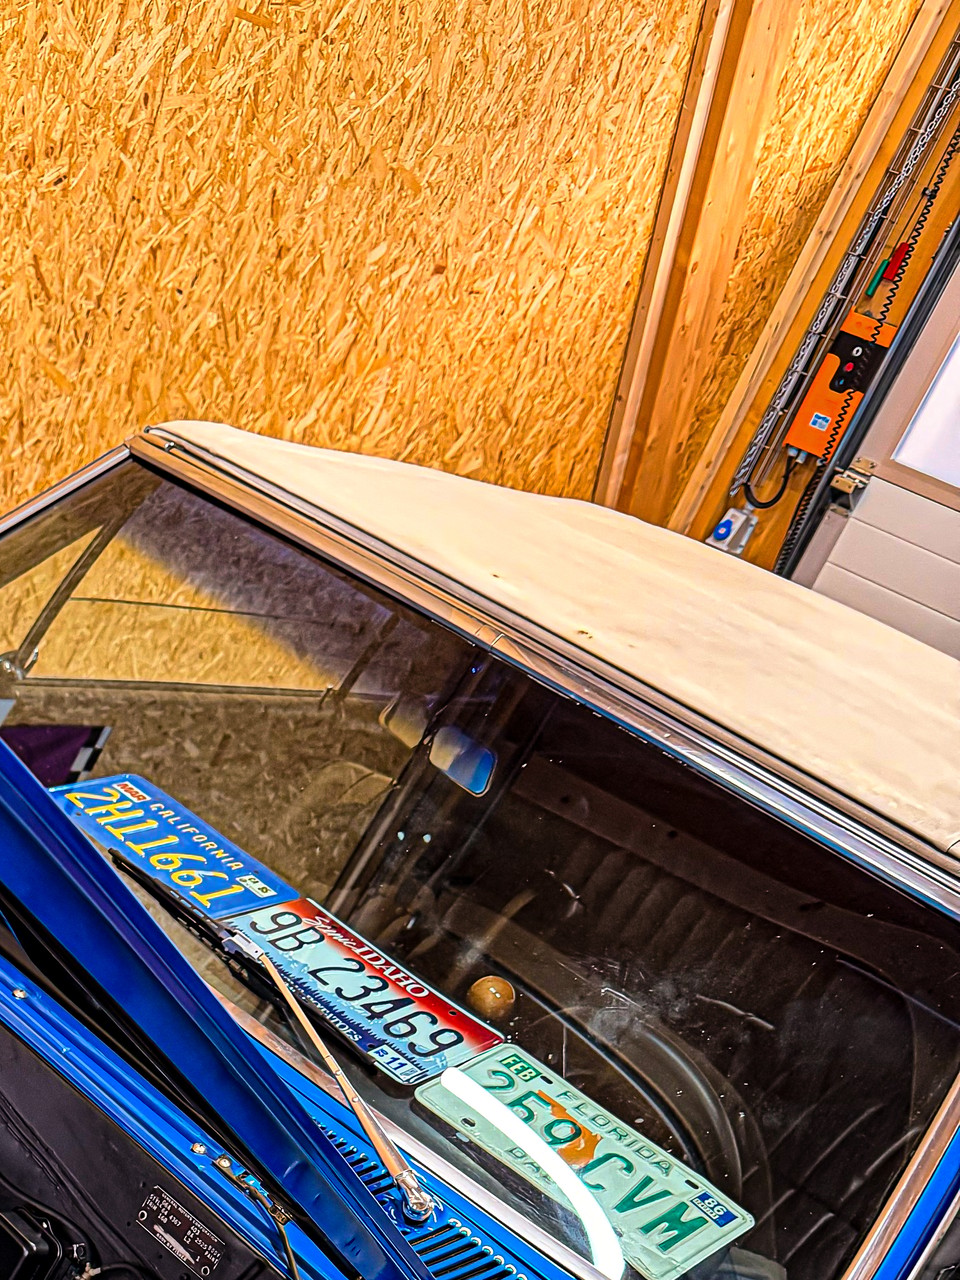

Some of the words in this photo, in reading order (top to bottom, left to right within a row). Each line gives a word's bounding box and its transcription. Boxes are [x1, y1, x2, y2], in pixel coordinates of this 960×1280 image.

[117, 782, 147, 802] MAR
[64, 787, 246, 908] 2H11661
[148, 803, 245, 871] CALIFORNIA
[249, 911, 325, 951] 9B
[307, 957, 464, 1058] 23469
[302, 915, 358, 949] Scenic
[354, 947, 430, 998] IDAHO
[502, 1054, 540, 1083] FEB
[556, 1091, 674, 1178] FLORIDA
[582, 1151, 709, 1253] CVM
[704, 1196, 728, 1217] 86
